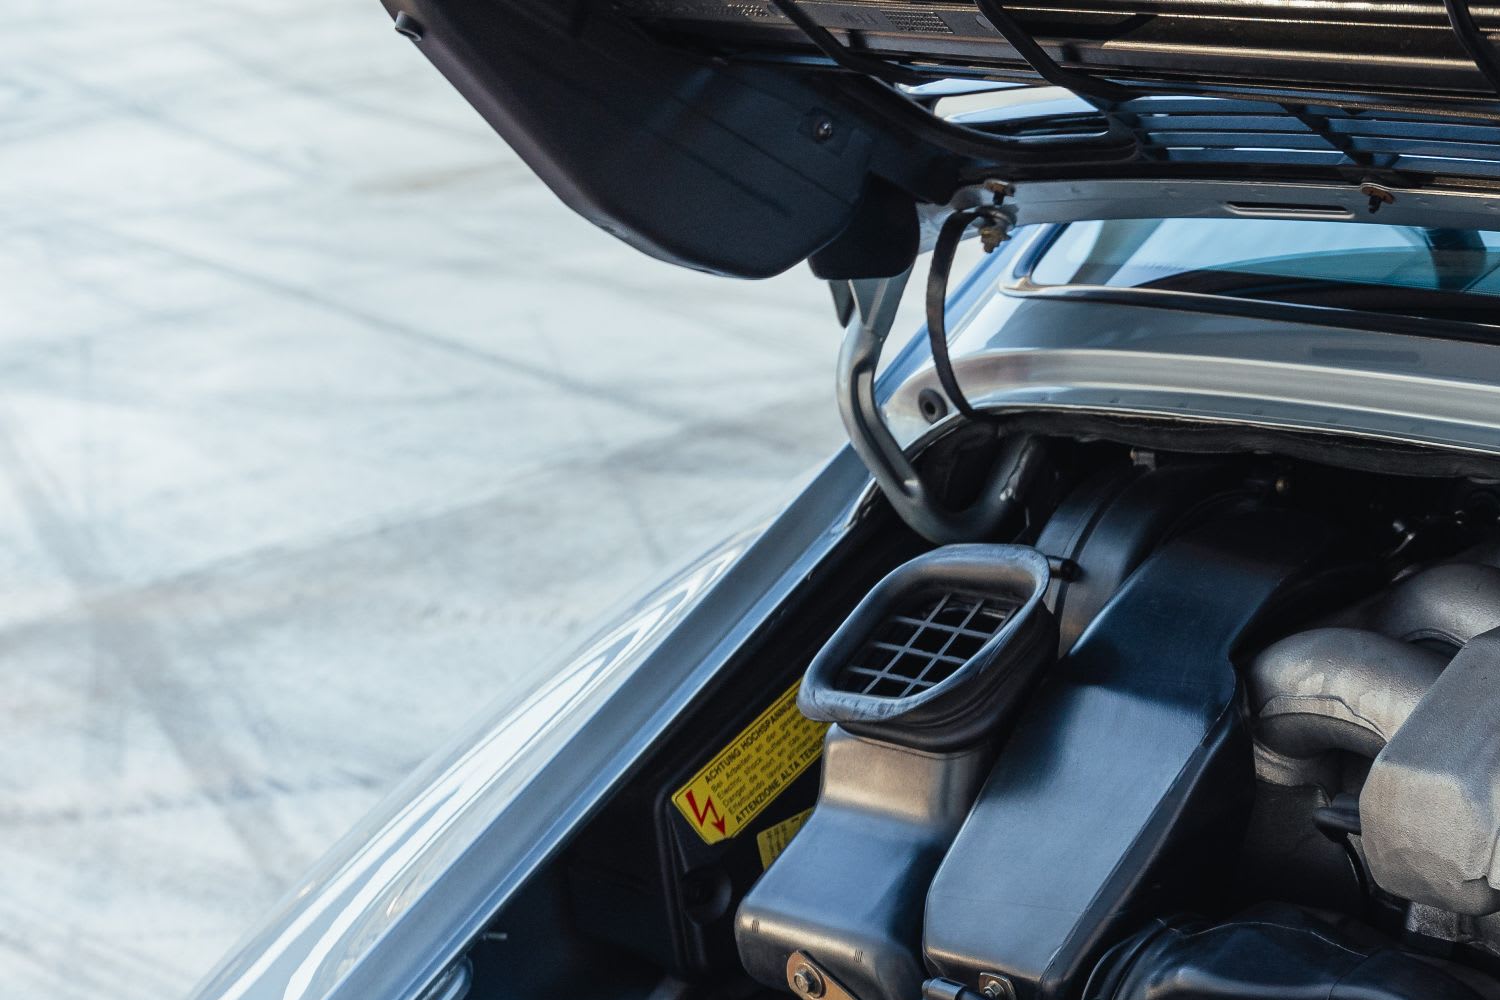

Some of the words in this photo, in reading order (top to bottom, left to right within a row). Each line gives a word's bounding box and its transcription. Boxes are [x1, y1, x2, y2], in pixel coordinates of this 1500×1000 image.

[705, 749, 741, 783] ACHTUNG
[741, 694, 799, 750] HOCHSPANNUN
[735, 779, 781, 824] ATTENZIONE
[781, 762, 801, 780] ALTA
[800, 735, 825, 761] TENSIO
